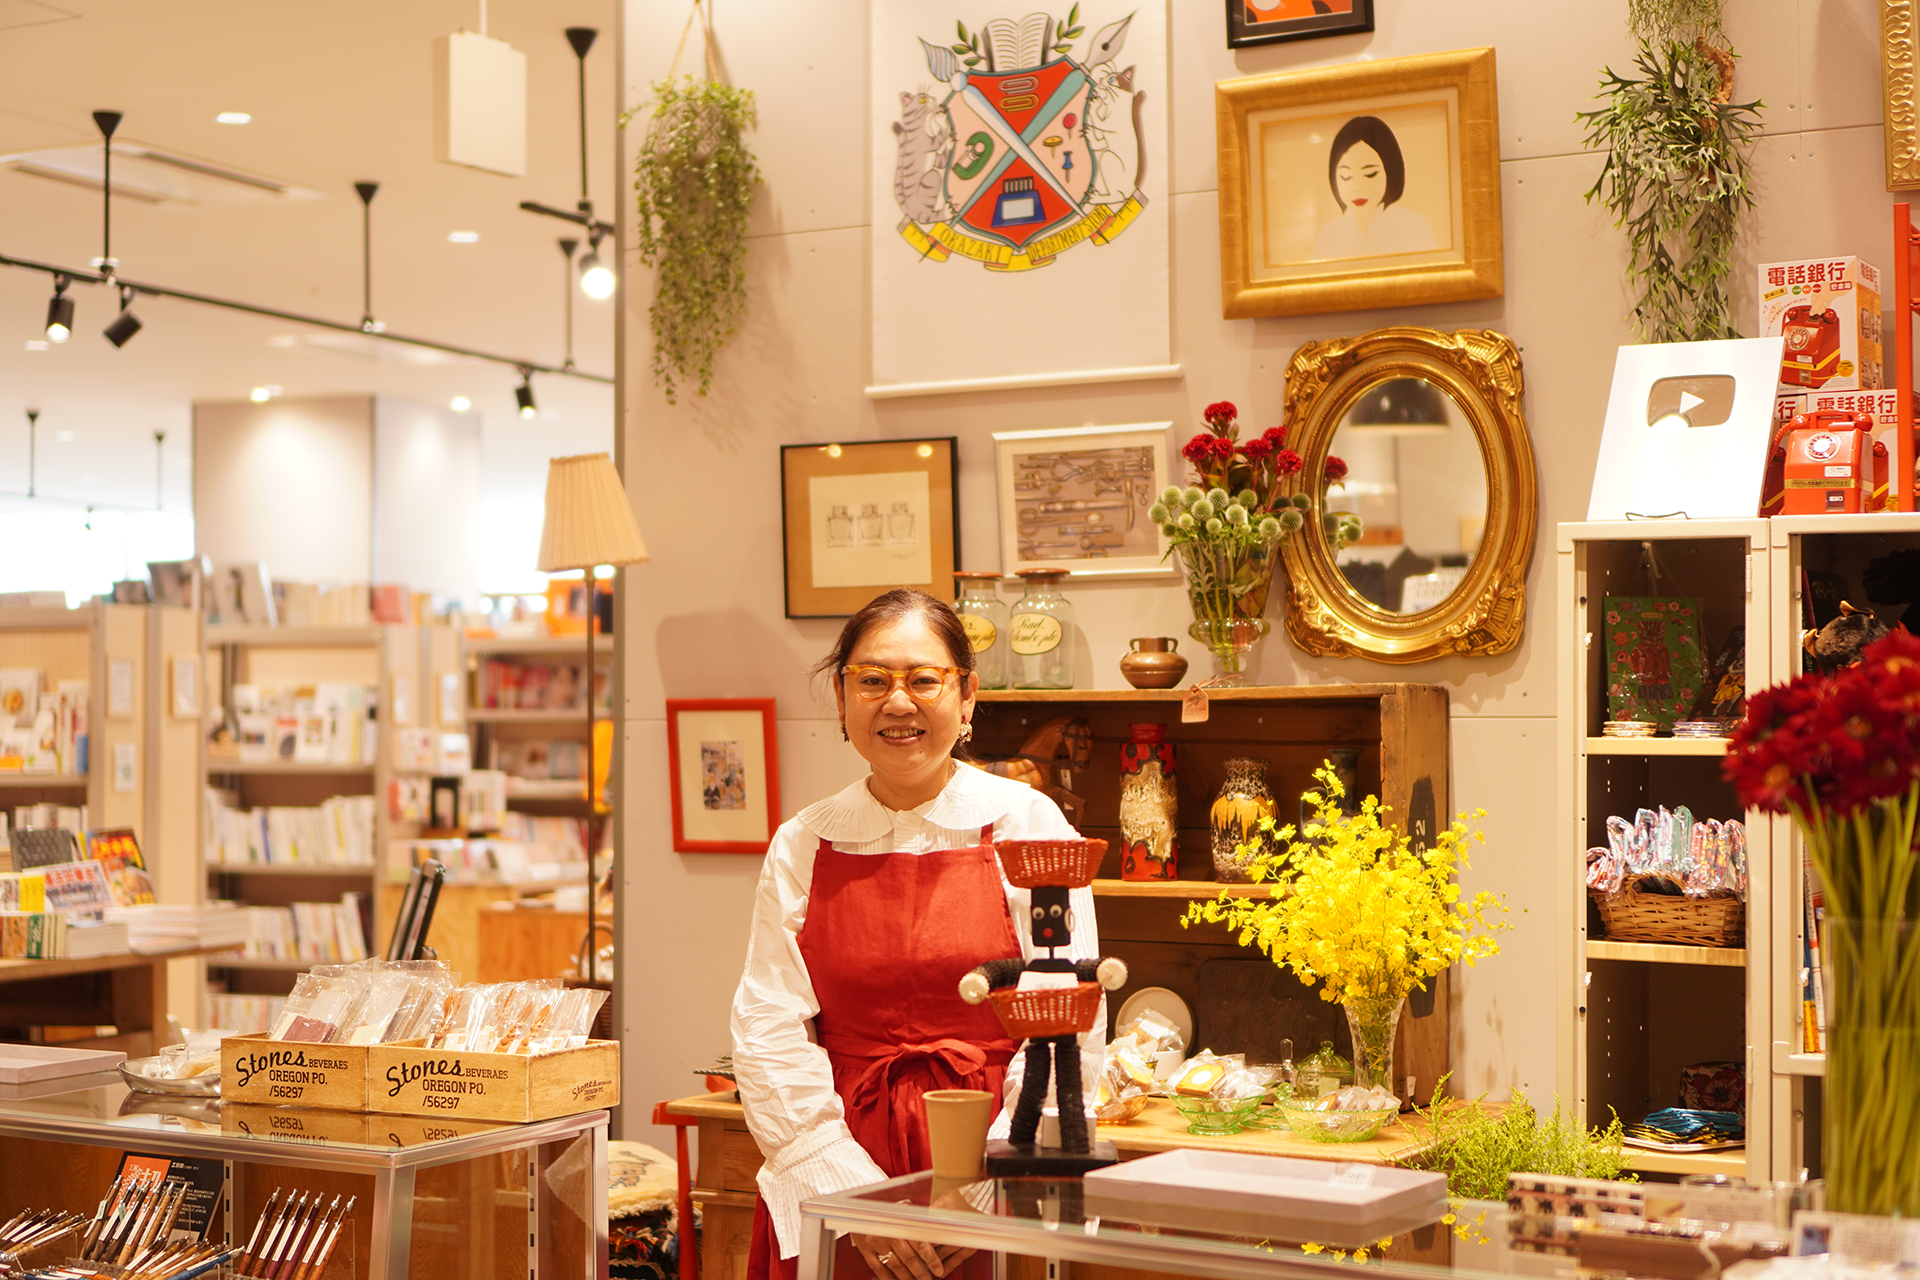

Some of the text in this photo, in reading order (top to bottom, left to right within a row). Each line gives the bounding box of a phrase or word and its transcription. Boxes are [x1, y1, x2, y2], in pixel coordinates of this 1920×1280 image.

[939, 206, 1109, 262] OKAZAKI DEPARTMENT STORE
[1768, 262, 1845, 286] 電話銀行
[236, 1050, 348, 1087] Stones BEVERAES
[269, 1069, 328, 1085] OREGON PO.
[386, 1059, 508, 1097] Stones BEVERAES
[269, 1085, 303, 1099] /56297
[422, 1079, 486, 1095] OREGON PO.
[422, 1096, 460, 1110] /56297
